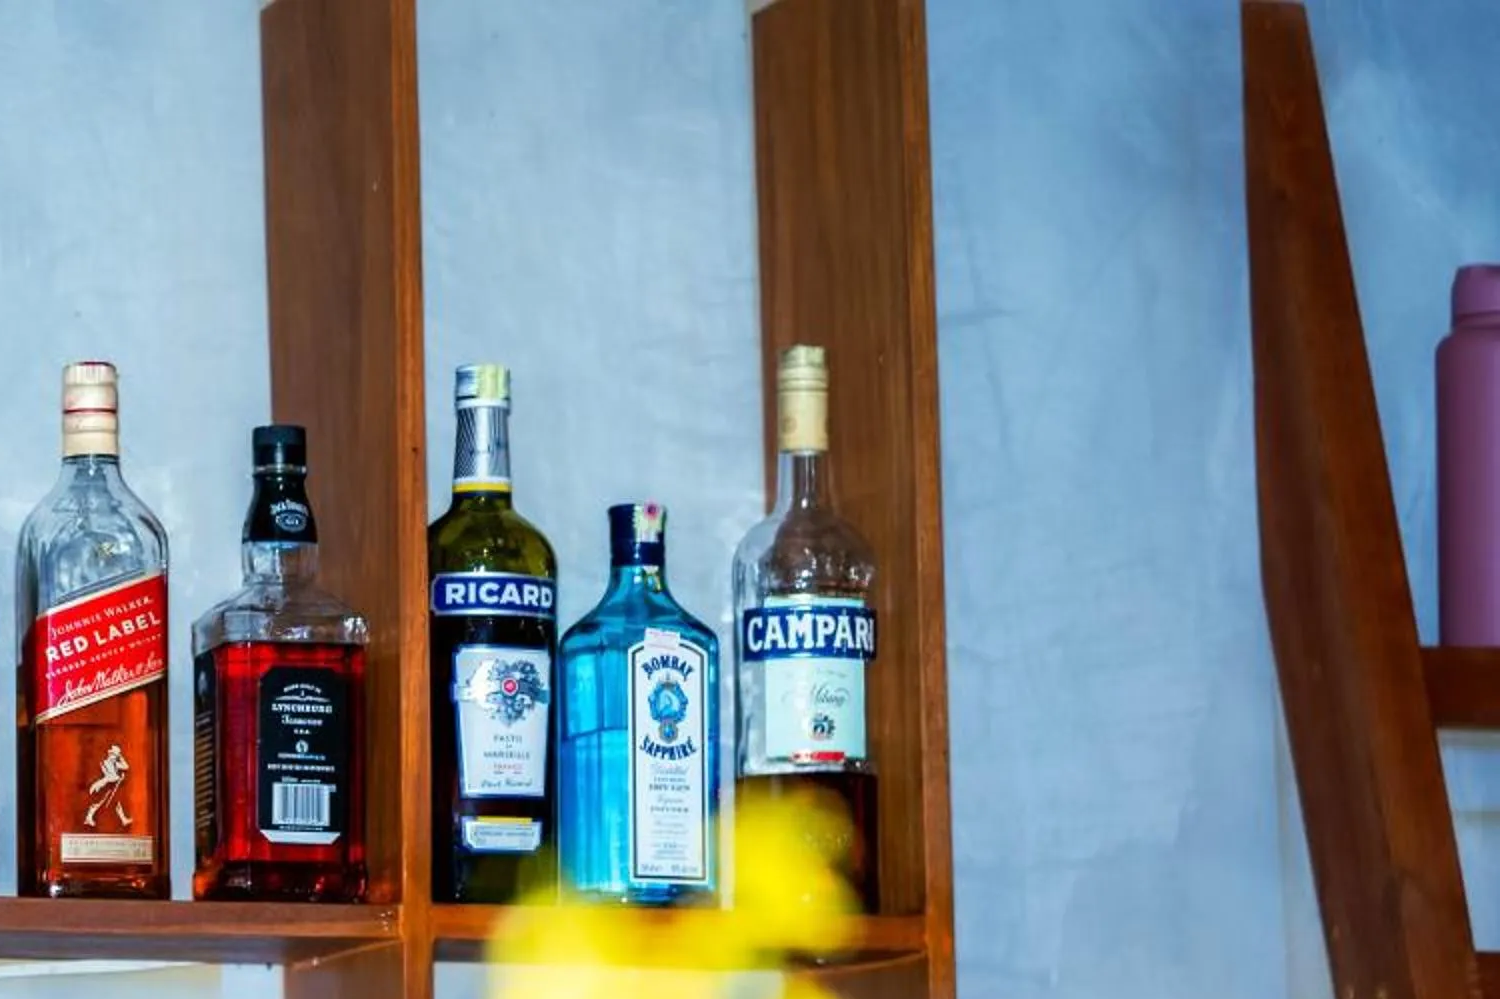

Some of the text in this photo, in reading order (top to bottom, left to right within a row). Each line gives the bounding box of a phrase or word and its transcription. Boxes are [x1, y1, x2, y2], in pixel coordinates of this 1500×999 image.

[445, 582, 553, 608] RICARD
[45, 611, 161, 663] RED LABEL
[748, 613, 874, 652] CAMPARI
[641, 655, 694, 681] BOMBAY
[640, 733, 696, 760] SAPPHIRE
